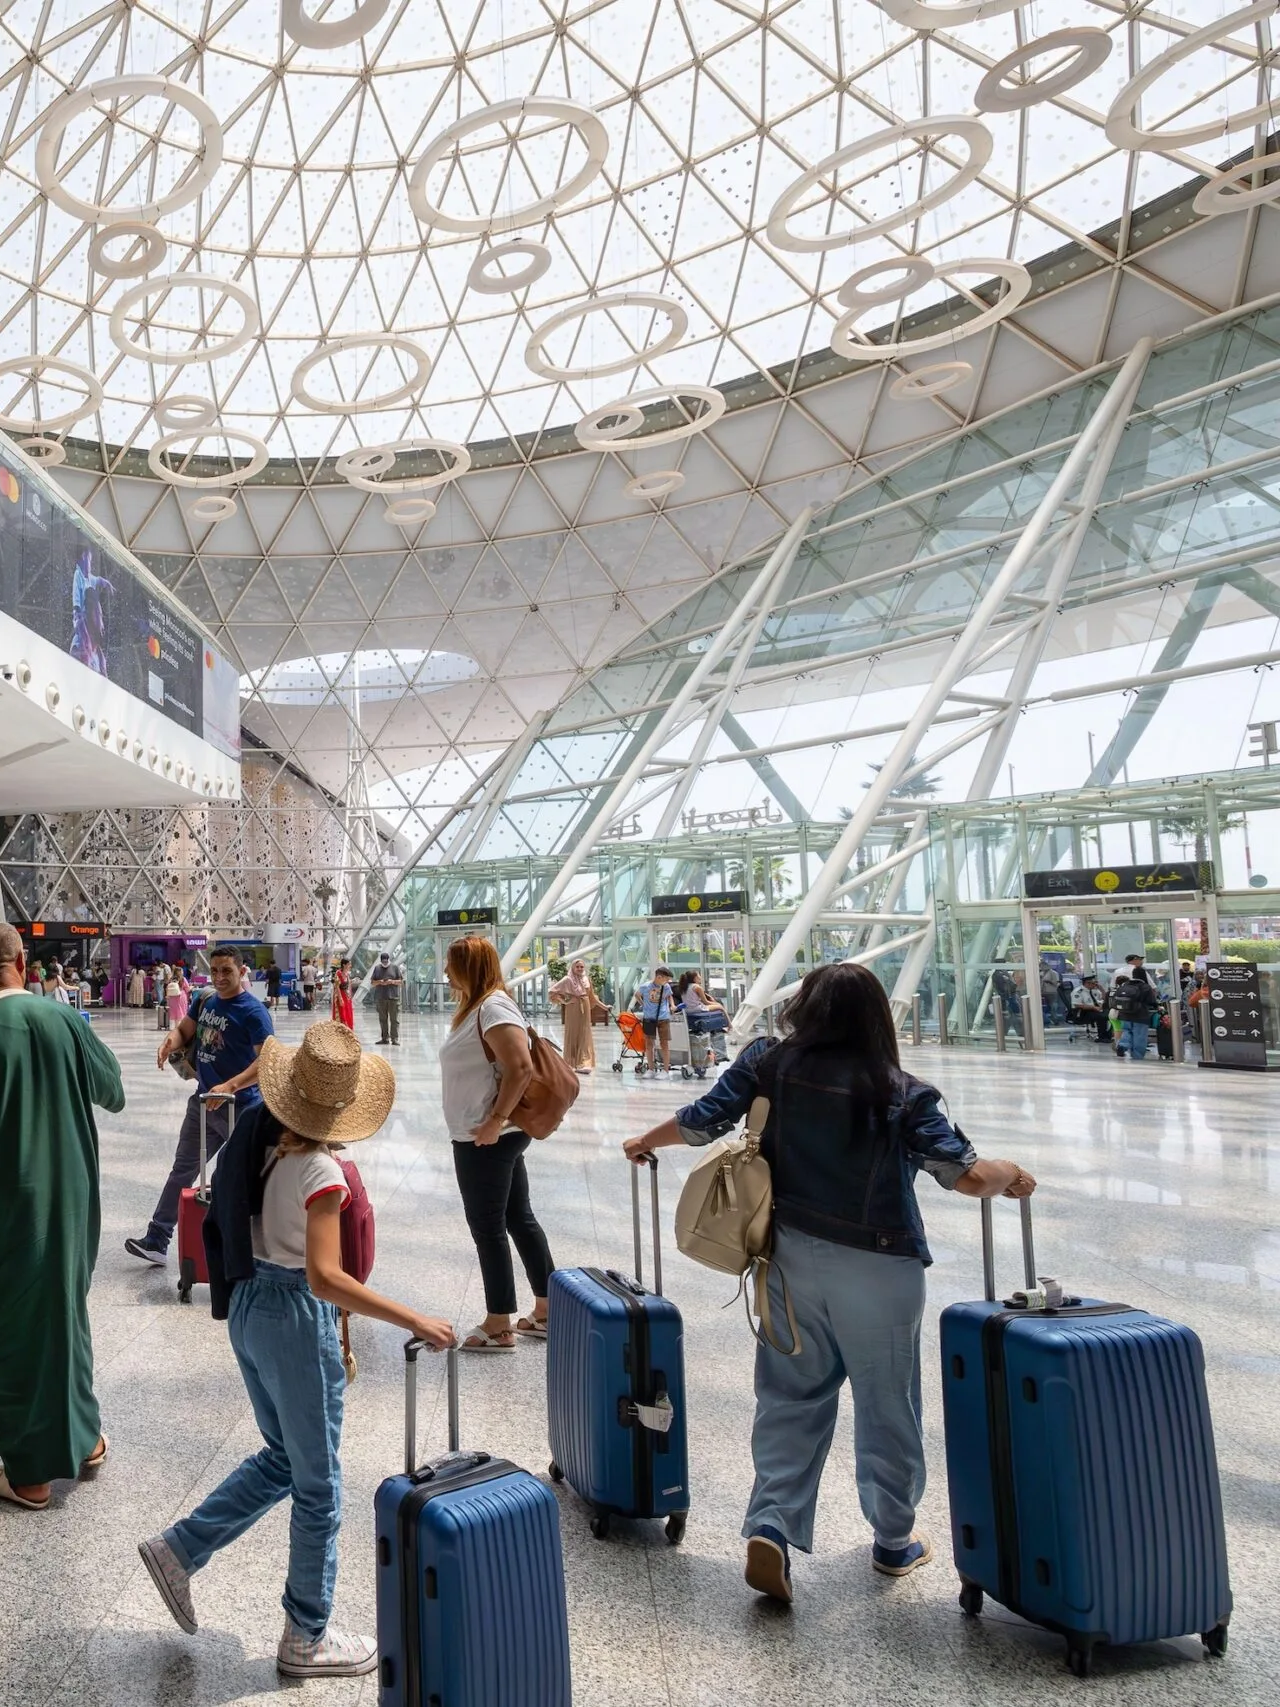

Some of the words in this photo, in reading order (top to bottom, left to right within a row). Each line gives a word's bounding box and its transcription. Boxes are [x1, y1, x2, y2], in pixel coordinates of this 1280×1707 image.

[1047, 878, 1071, 888] Exit
[1135, 871, 1183, 888] خروج
[708, 897, 733, 910] خروج
[70, 925, 99, 935] Orange
